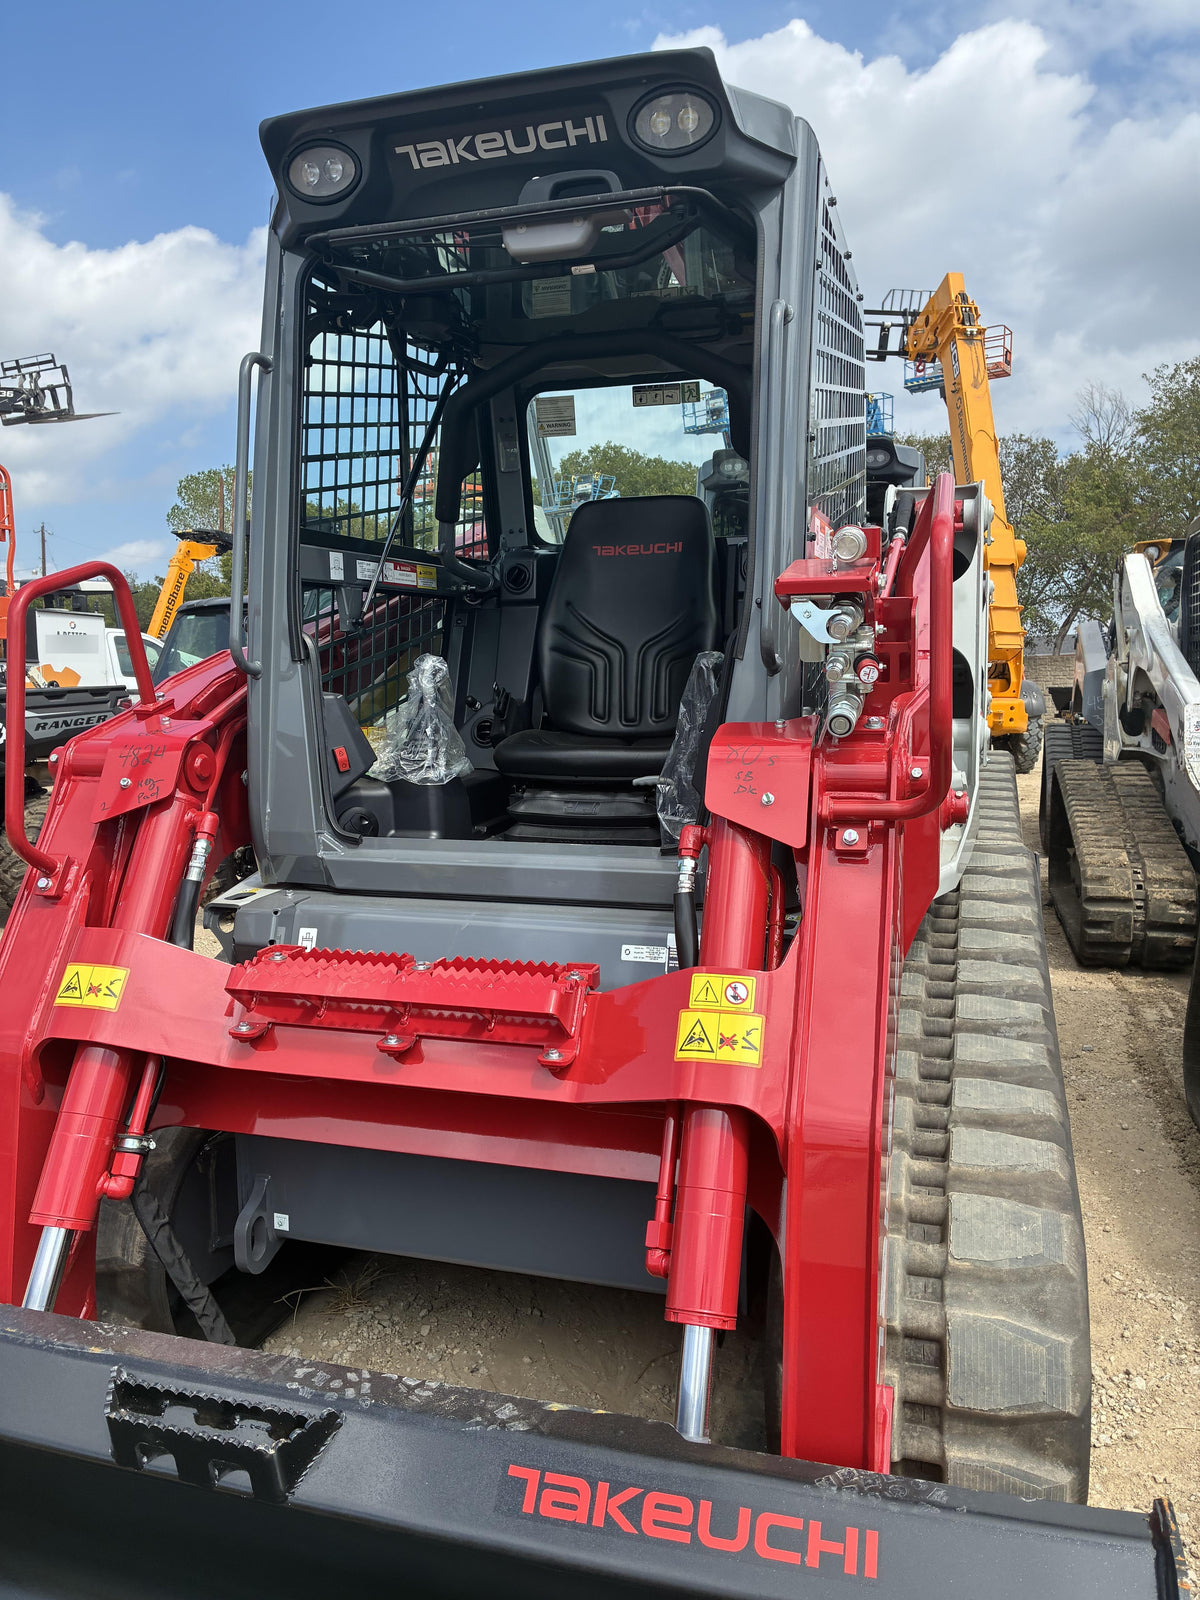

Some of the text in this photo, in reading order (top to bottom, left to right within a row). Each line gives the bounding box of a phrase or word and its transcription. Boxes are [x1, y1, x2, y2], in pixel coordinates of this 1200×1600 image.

[950, 340, 961, 380] JCB
[34, 714, 108, 732] RANGER
[118, 744, 167, 768] 4824
[507, 1464, 879, 1579] TAKEUCHI
